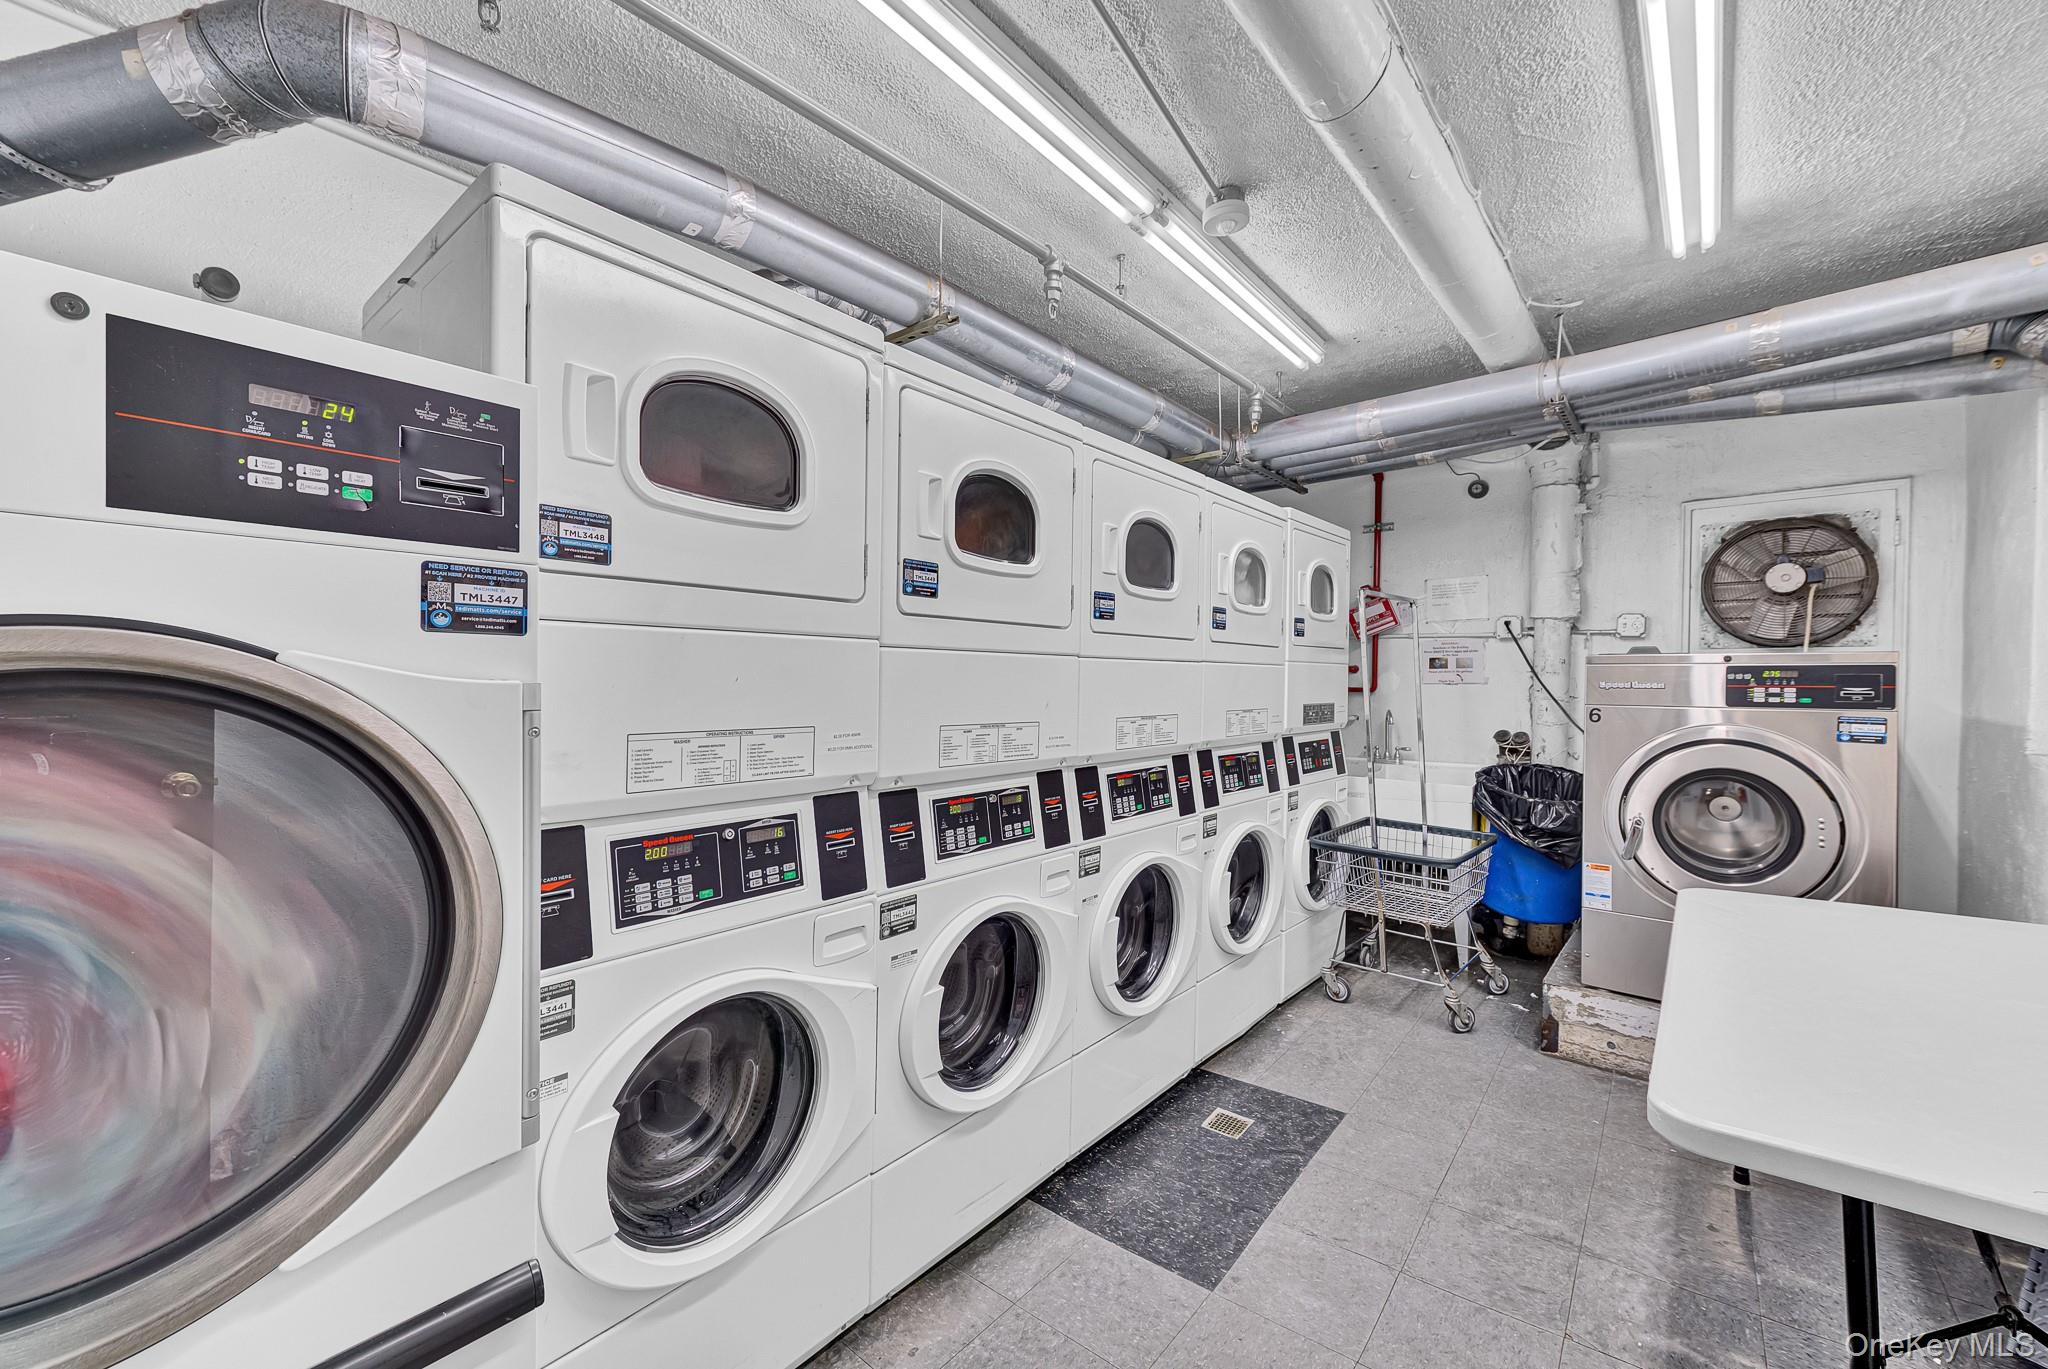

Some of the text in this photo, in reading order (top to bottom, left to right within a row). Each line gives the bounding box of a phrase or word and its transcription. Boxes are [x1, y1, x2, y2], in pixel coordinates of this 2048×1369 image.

[322, 402, 355, 422] 24
[563, 530, 605, 540] TML3448
[460, 592, 518, 604] TML3447
[1600, 681, 1665, 690] Speed Queen
[1589, 708, 1601, 723] 6
[774, 827, 784, 838] 16
[642, 834, 694, 847] Speed Queen
